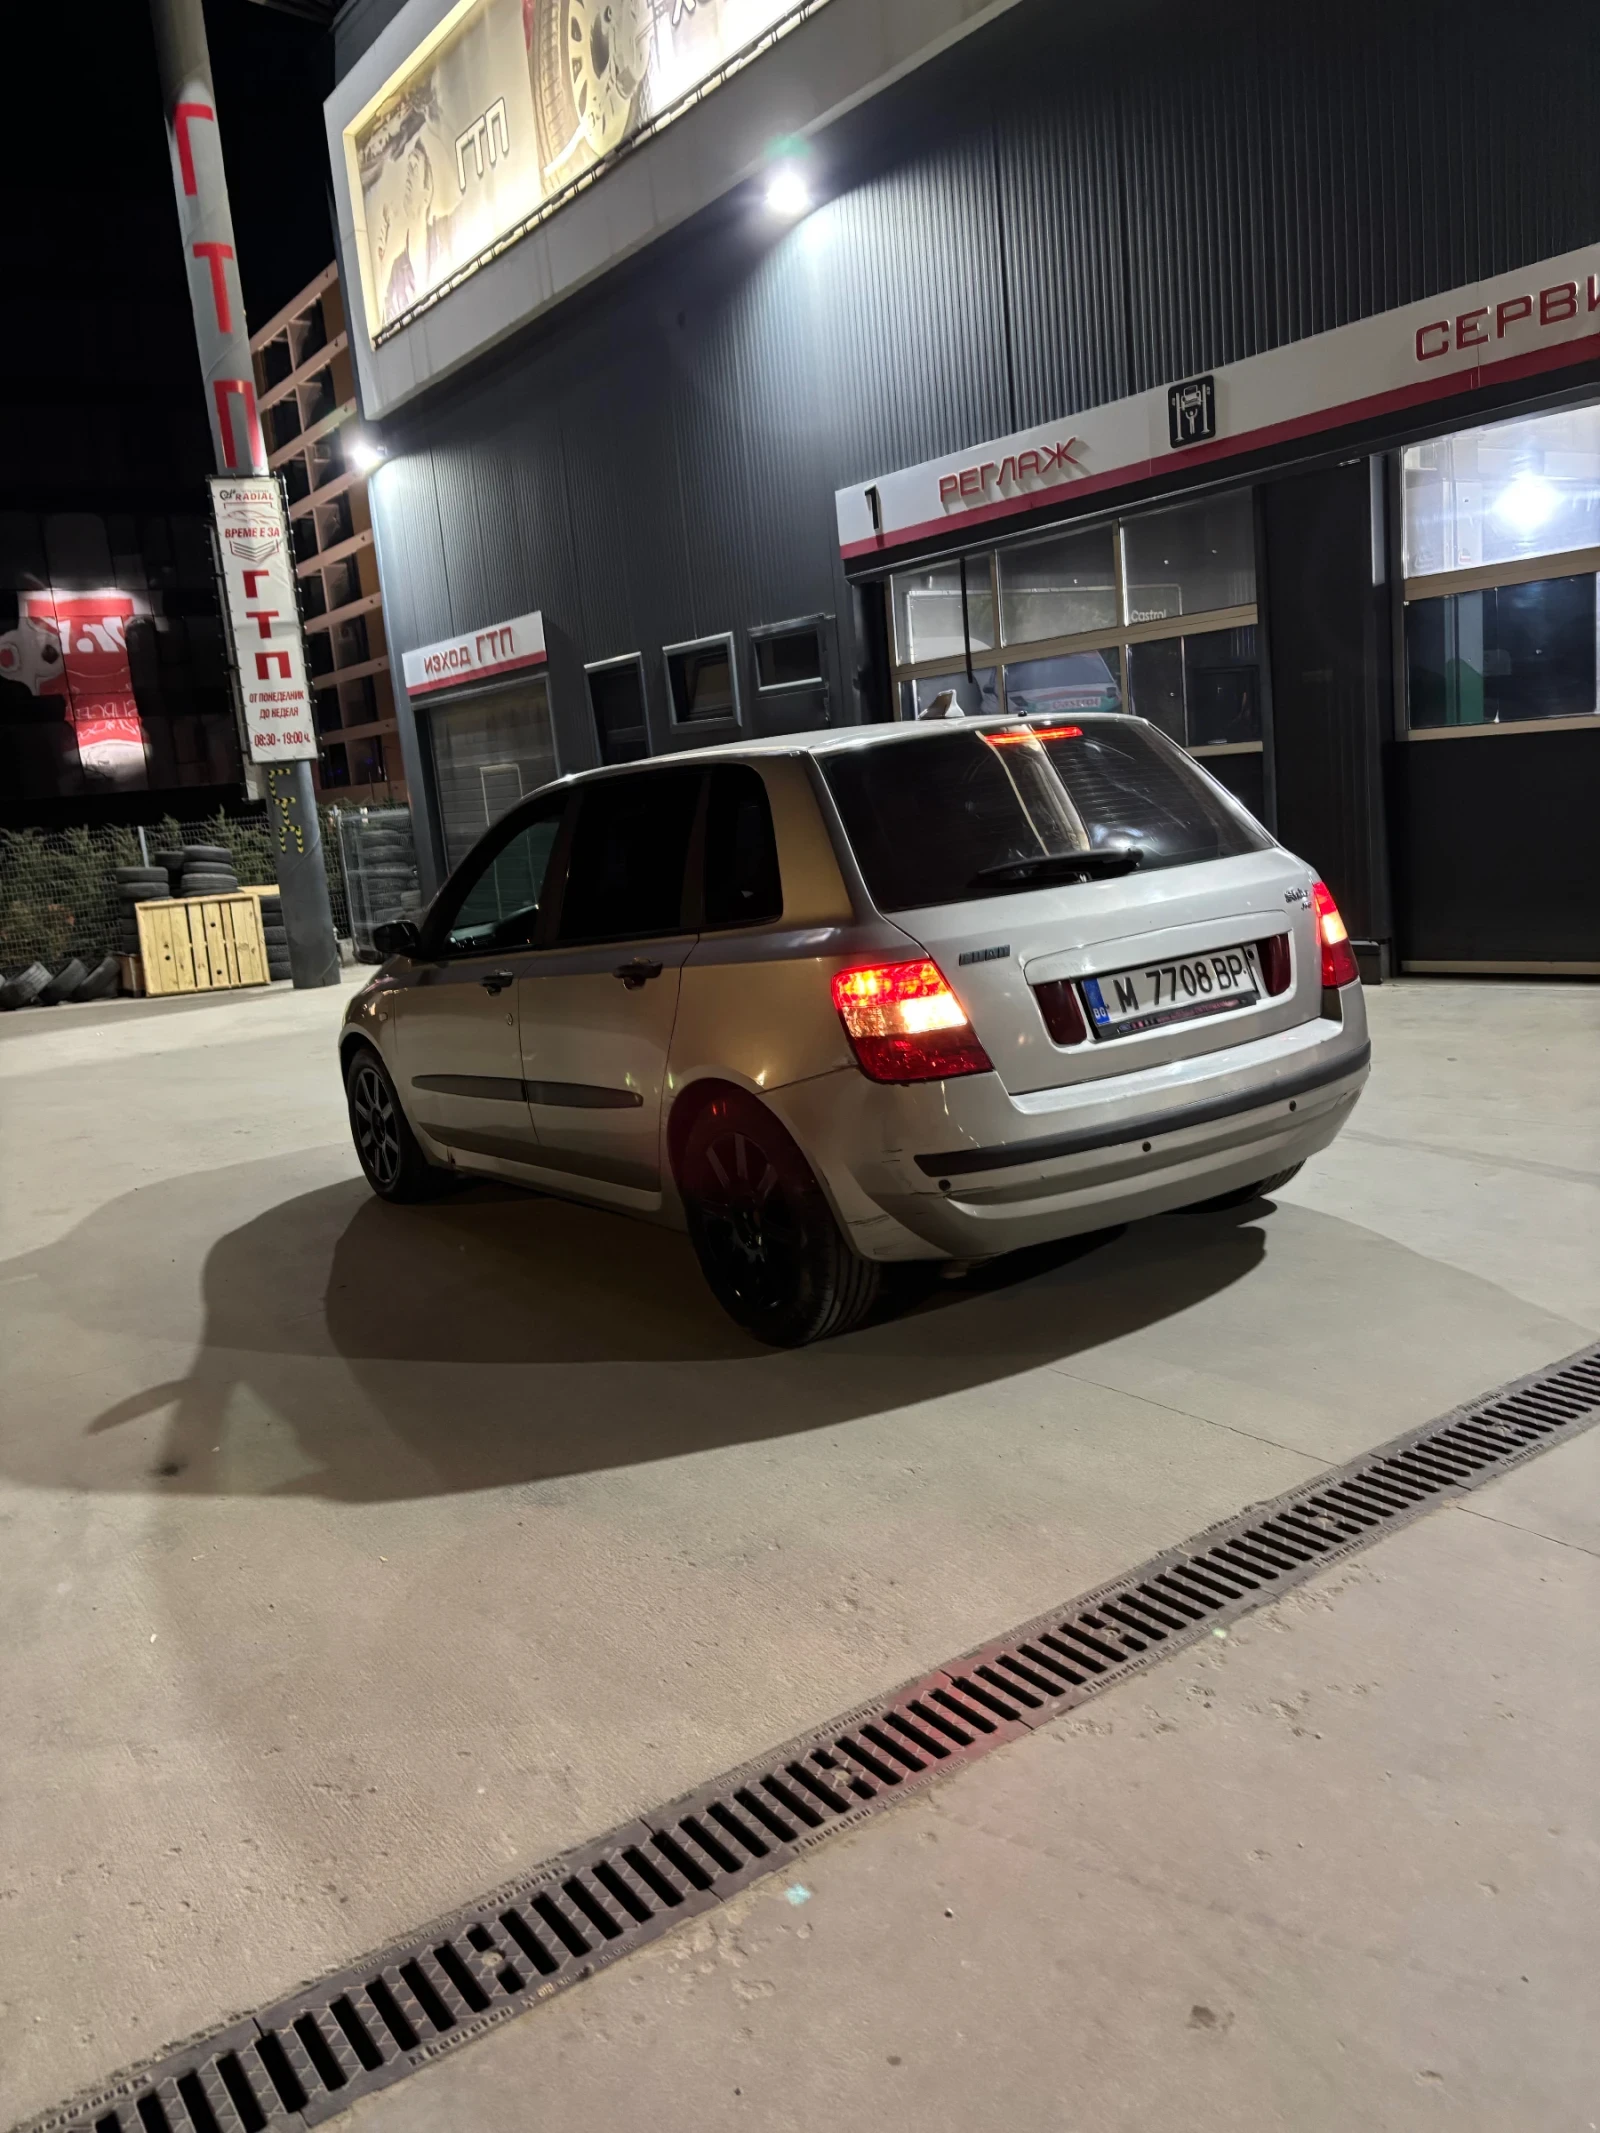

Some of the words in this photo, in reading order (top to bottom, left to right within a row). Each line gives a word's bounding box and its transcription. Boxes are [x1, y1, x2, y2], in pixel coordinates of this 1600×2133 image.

[455, 96, 509, 193] ГТП
[938, 436, 1079, 502] РЕГЛАЖ
[235, 492, 274, 501] RADIAL
[225, 528, 257, 538] ВРЕМЕ
[260, 528, 266, 537] Е
[267, 526, 280, 537] ЗА
[1131, 609, 1167, 621] Castrol
[424, 645, 472, 675] ИЗХОД
[475, 626, 515, 663] ГТП
[249, 693, 258, 702] ОТ
[259, 690, 304, 702] ПОНЕДЕЛНИК
[259, 708, 270, 719] ДО
[270, 706, 299, 718] НЕДЕЛЯ
[254, 732, 276, 747] 08:30
[282, 730, 303, 744] 19:00
[1092, 1006, 1107, 1019] BG
